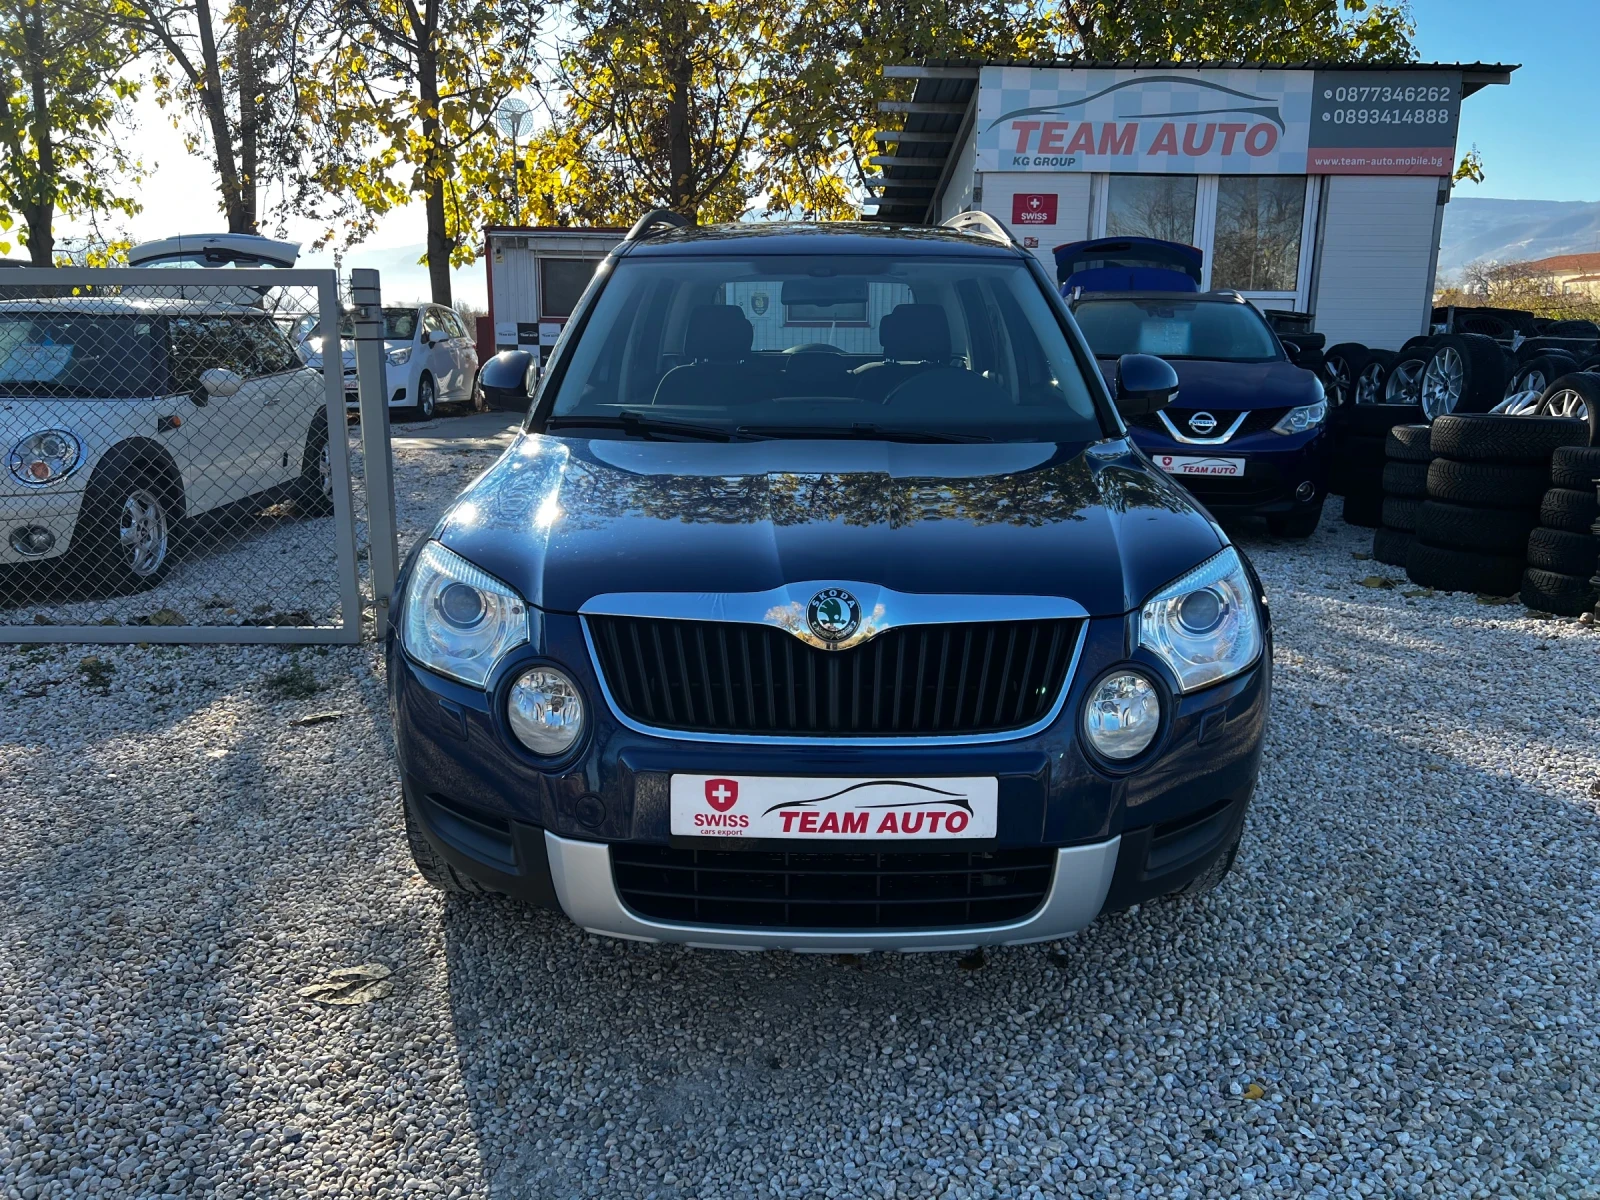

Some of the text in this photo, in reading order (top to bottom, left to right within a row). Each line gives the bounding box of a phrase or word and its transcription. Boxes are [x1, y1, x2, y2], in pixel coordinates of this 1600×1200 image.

[1335, 86, 1451, 102] 0877346262
[1333, 108, 1449, 124] 0893414888
[1011, 121, 1278, 157] TEAM AUTO
[1012, 156, 1076, 167] KG GROUP
[1314, 156, 1443, 167] www.team-auto.mobile.bg
[1021, 212, 1048, 220] SWISS
[812, 590, 856, 608] SKODA
[694, 813, 749, 828] SWISS
[779, 811, 969, 834] TEAM AUTO
